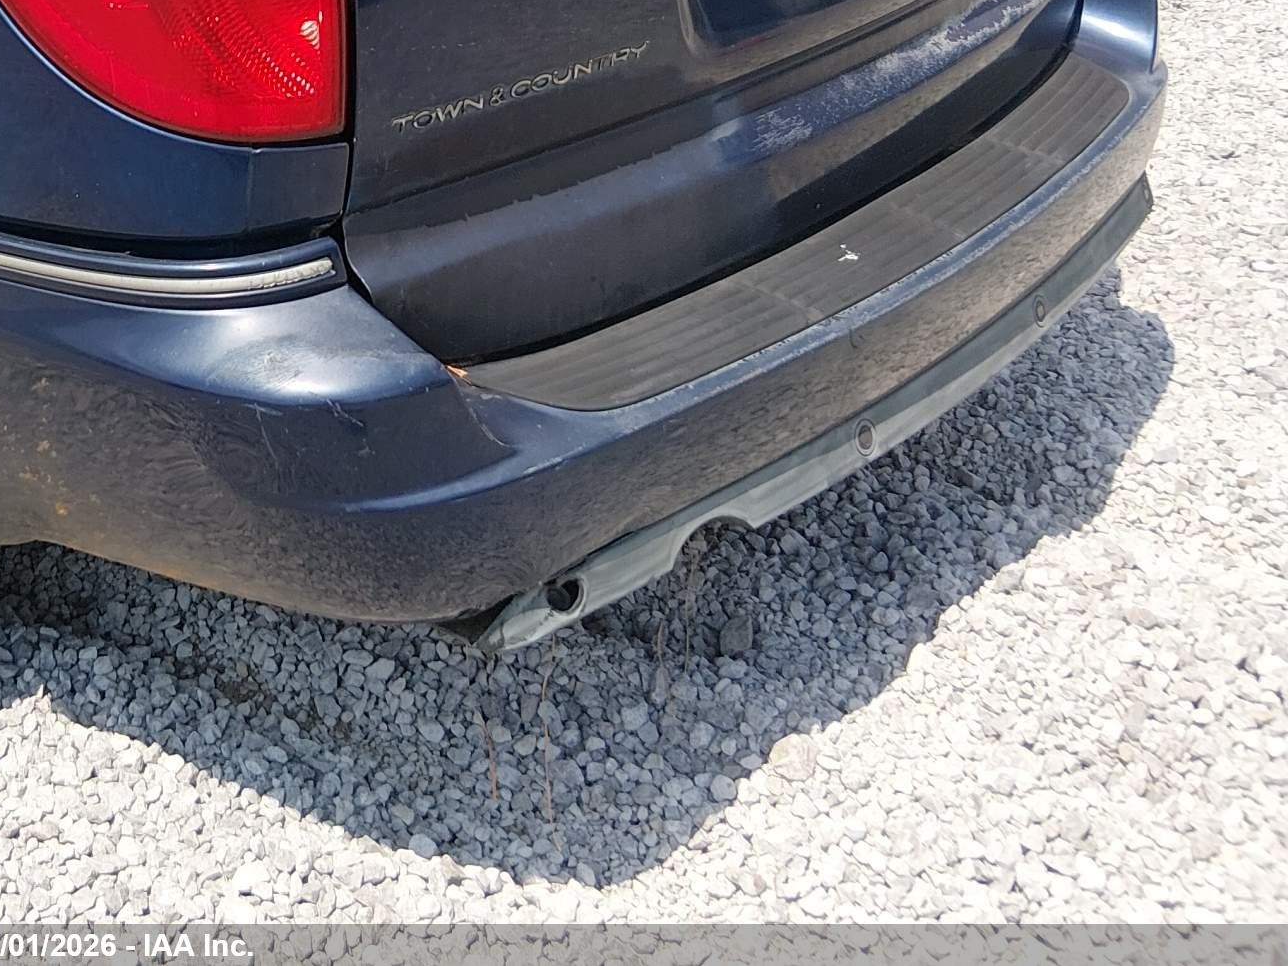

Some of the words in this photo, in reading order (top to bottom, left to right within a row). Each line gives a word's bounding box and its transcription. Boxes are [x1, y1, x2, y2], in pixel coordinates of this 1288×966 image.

[391, 93, 484, 134] TOWN
[488, 86, 505, 108] &
[510, 40, 651, 99] COUNTRY
